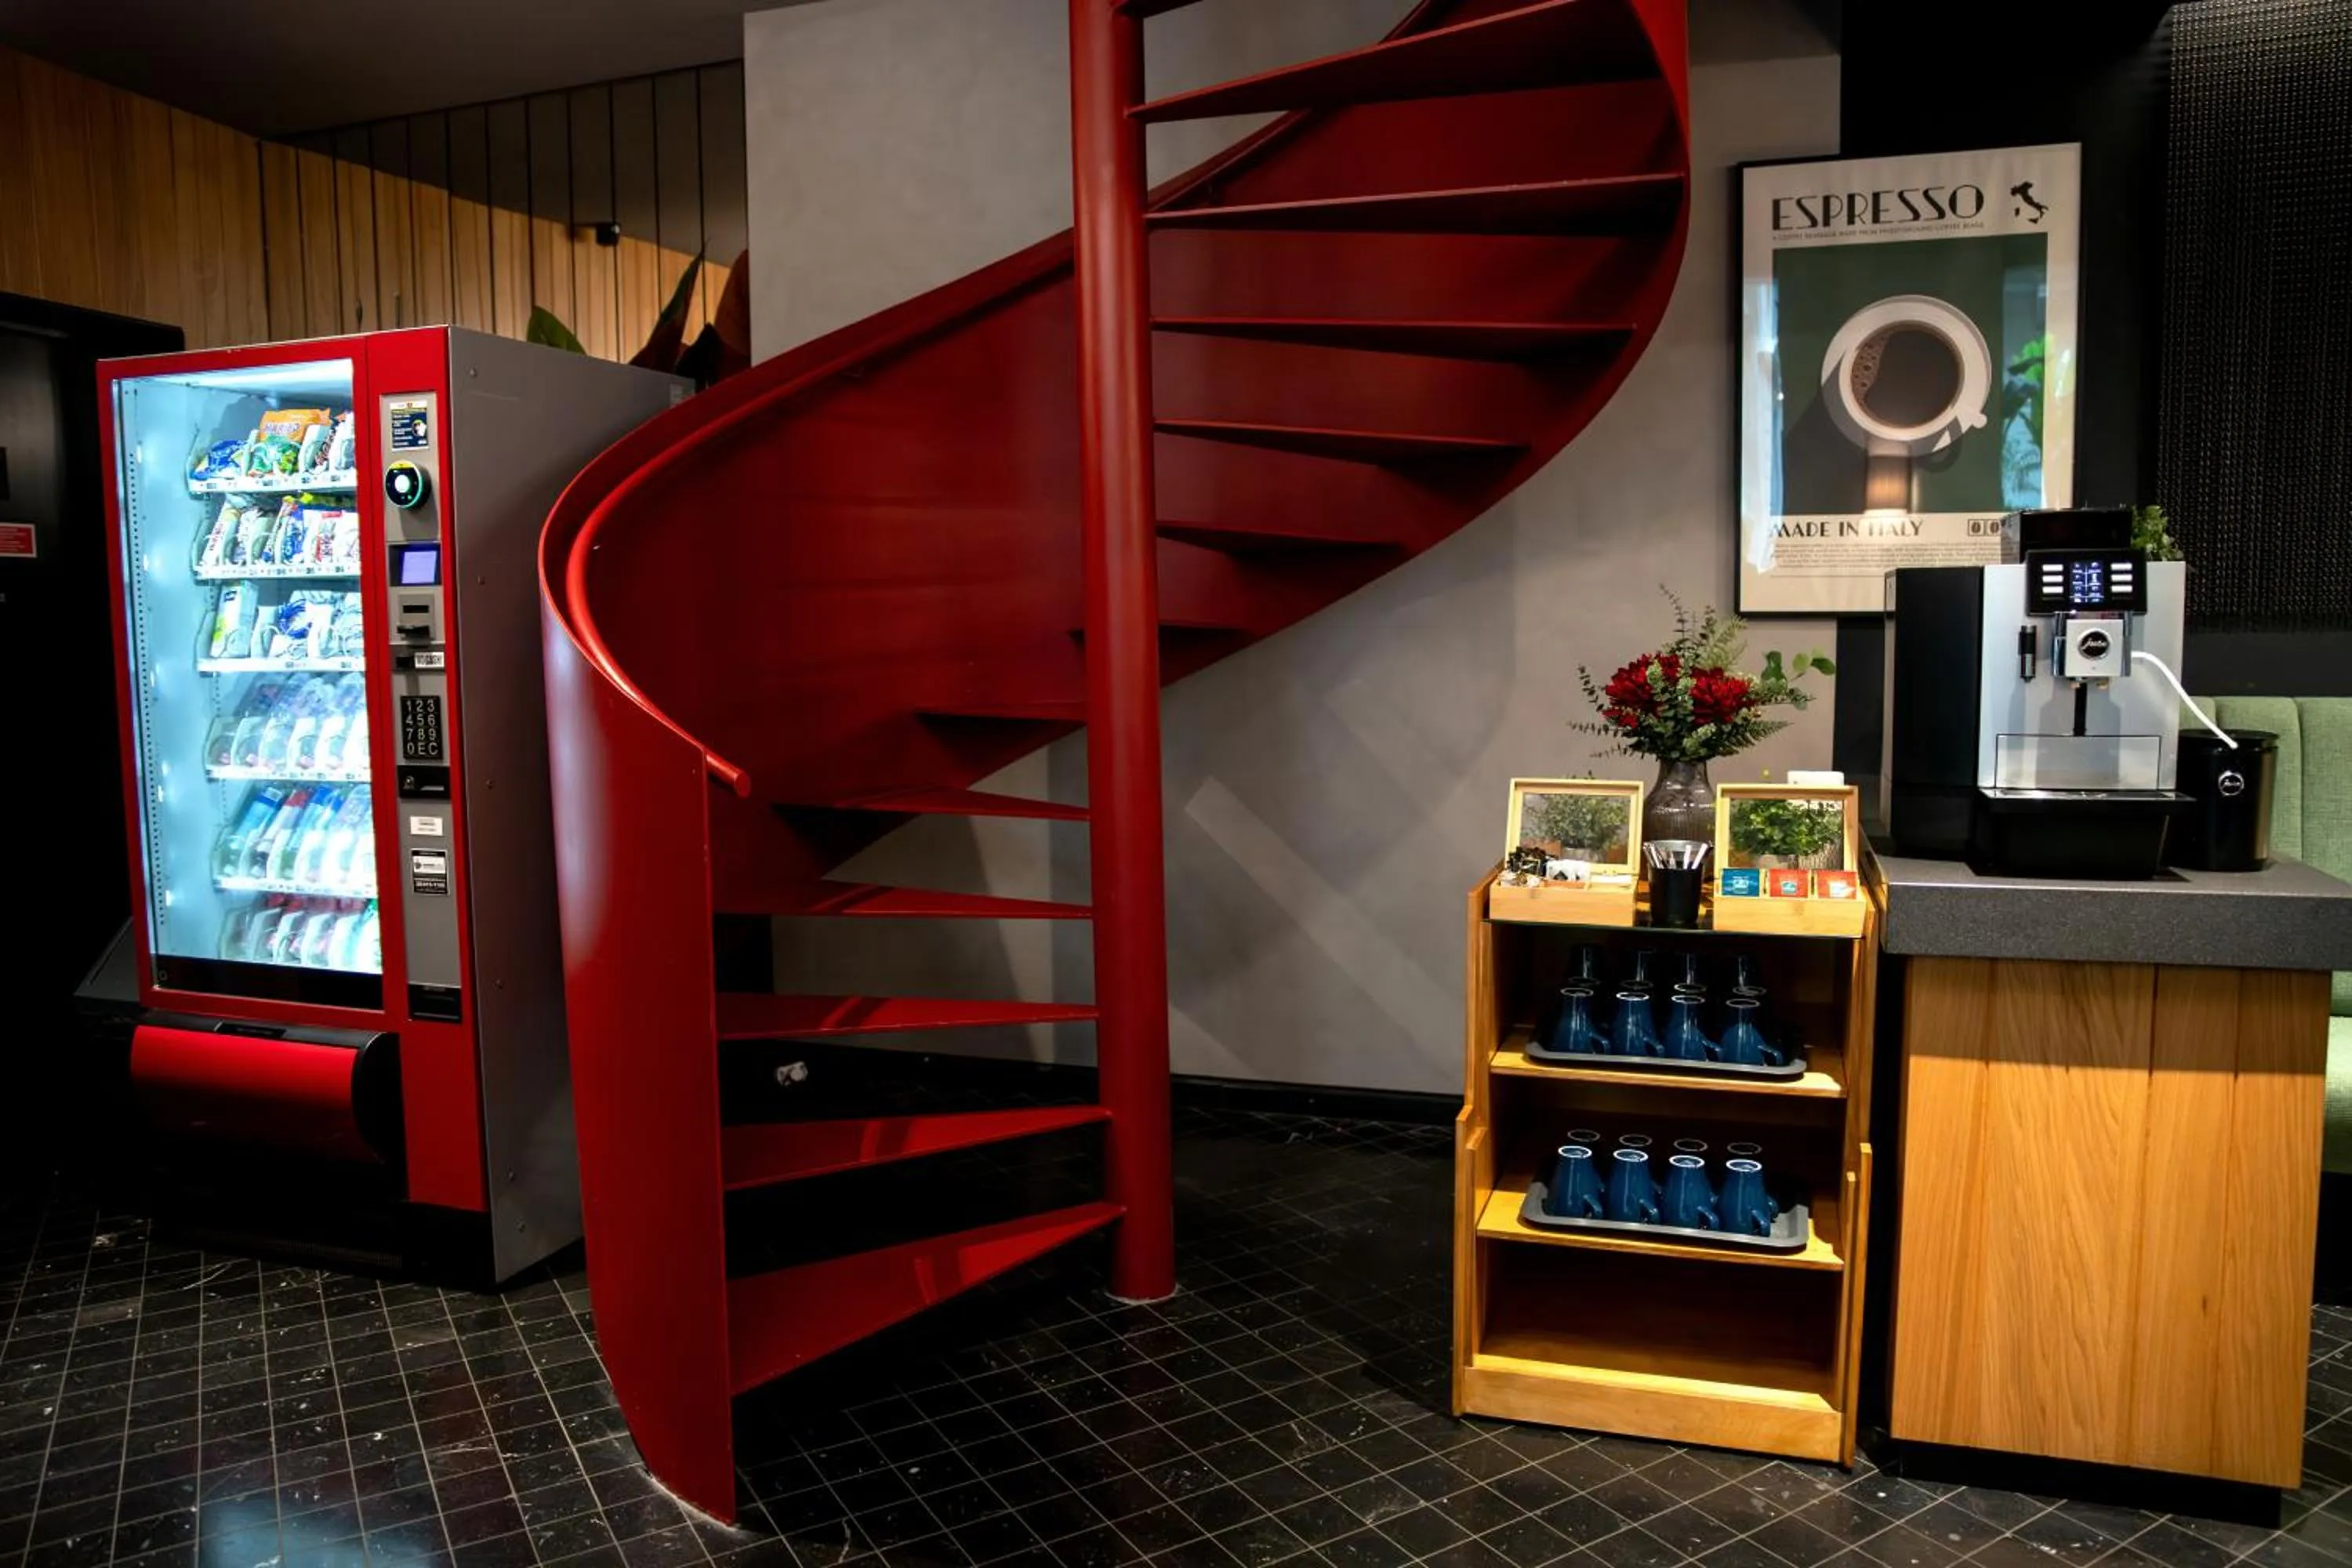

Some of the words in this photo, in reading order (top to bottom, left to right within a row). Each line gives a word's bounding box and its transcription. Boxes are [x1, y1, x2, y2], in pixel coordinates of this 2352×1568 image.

[1772, 184, 1984, 230] ESPRESSO
[1769, 521, 1831, 538] MADE
[1838, 521, 1859, 537] IN
[406, 700, 412, 711] 1
[416, 700, 423, 713] 2
[427, 700, 435, 713] 3
[405, 714, 413, 725] 4
[416, 714, 424, 726] 5
[427, 714, 435, 727] 6
[406, 728, 414, 740] 7
[417, 728, 425, 740] 8
[428, 728, 437, 741] 9
[418, 742, 426, 755] E
[429, 742, 438, 756] C
